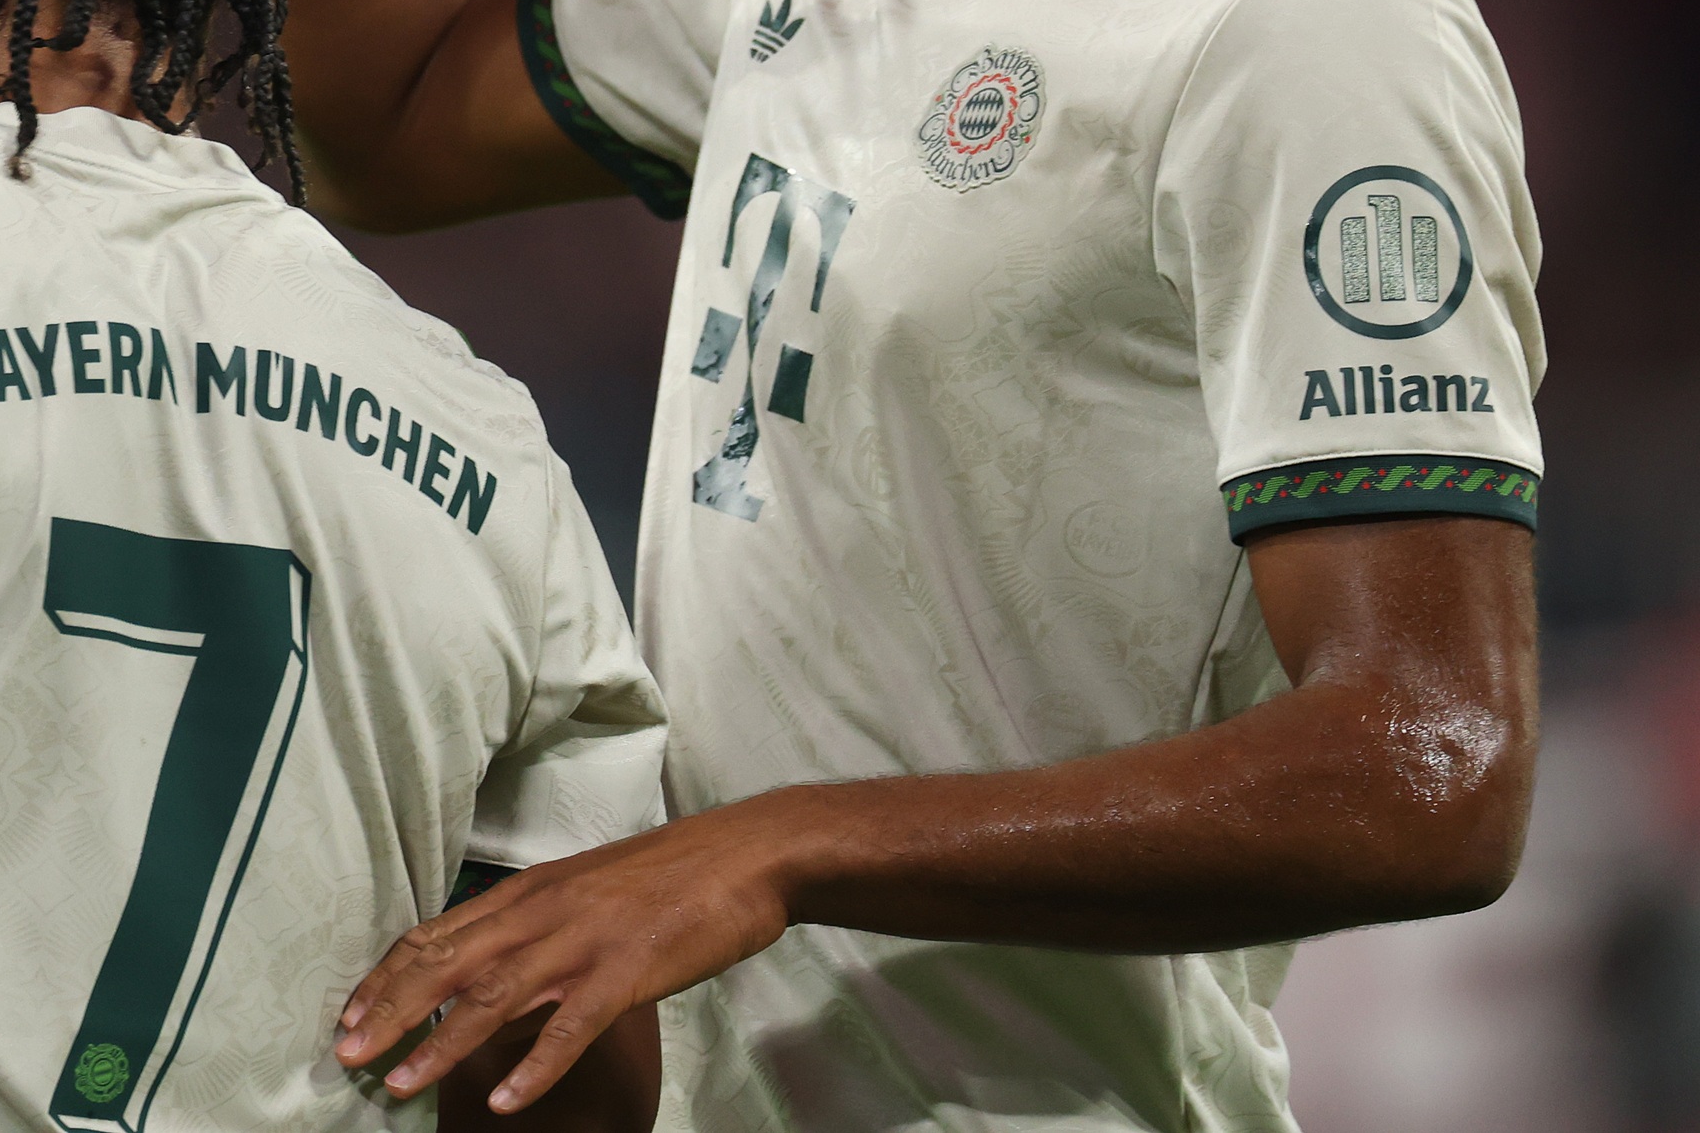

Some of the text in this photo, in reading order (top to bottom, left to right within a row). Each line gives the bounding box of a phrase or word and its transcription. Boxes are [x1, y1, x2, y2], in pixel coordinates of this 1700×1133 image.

[195, 342, 497, 536] MÜNCHEN
[1299, 364, 1495, 421] Allianz
[43, 517, 314, 1133] 7
